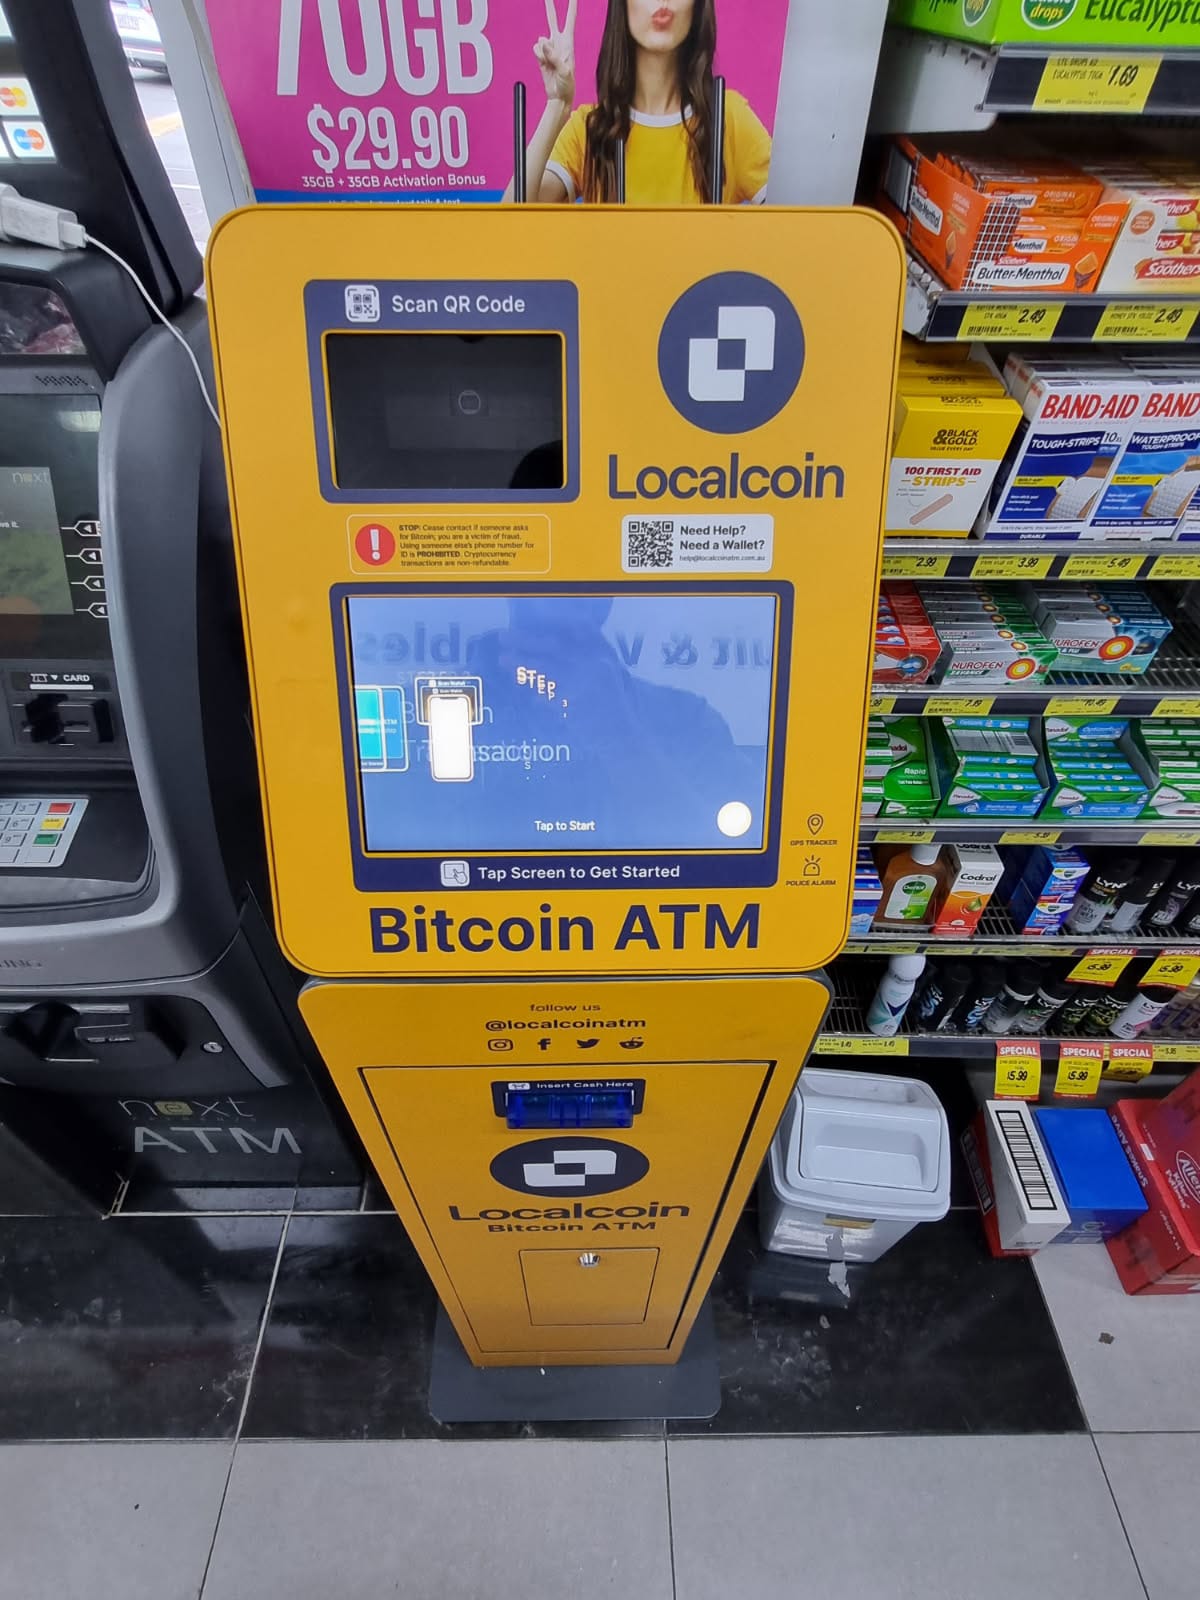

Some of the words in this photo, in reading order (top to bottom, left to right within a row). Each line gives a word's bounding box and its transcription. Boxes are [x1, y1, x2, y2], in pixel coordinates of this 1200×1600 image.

[1029, 5, 1064, 22] drops
[307, 103, 469, 173] $29.90
[302, 176, 335, 187] 35GB
[348, 176, 381, 187] 35GB
[383, 174, 445, 187] Activation
[448, 173, 487, 185] Bonus
[1014, 241, 1044, 250] Menthol
[977, 266, 1064, 281] Butter-Menthol
[391, 294, 437, 314] Scan
[442, 294, 472, 315] QR
[483, 294, 526, 313] Code
[1040, 394, 1140, 419] BAND-AID
[933, 429, 947, 445] &
[947, 429, 980, 437] BLACK
[1031, 437, 1101, 449] TOUGH-STRIPS
[609, 452, 844, 499] Localcoin
[905, 467, 924, 475] 100
[926, 467, 961, 476] FIRST
[961, 467, 982, 476] AID
[912, 476, 967, 487] STRIPS
[399, 524, 421, 532] STOP:
[680, 525, 711, 535] Need
[713, 525, 746, 537] Help?
[474, 543, 496, 551] phone
[680, 540, 711, 550] Need
[713, 542, 719, 550] a
[722, 540, 765, 550] Wallet?
[951, 661, 1004, 670] NUROFEN
[63, 674, 90, 682] CARD
[904, 767, 926, 776] Rapid
[534, 820, 553, 832] Tap
[556, 821, 567, 831] to
[569, 820, 595, 831] Start
[478, 865, 505, 883] Tap
[511, 864, 565, 881] Screen
[569, 866, 585, 880] to
[590, 864, 618, 880] Get
[622, 863, 680, 880] Started
[960, 873, 997, 882] Codral
[369, 904, 595, 954] Bitcoin
[614, 903, 760, 950] ATM
[530, 1004, 577, 1012] follow
[582, 1004, 601, 1012] us
[485, 1018, 647, 1032] @localcoinatm
[1000, 1046, 1037, 1055] SPECIAL
[1063, 1047, 1101, 1057] SPECIAL
[1113, 1048, 1150, 1057] SPECIAL
[134, 1126, 302, 1153] ATM
[449, 1202, 690, 1221] Localcoin
[488, 1223, 583, 1232] Bitcoin
[592, 1221, 656, 1232] ATM
